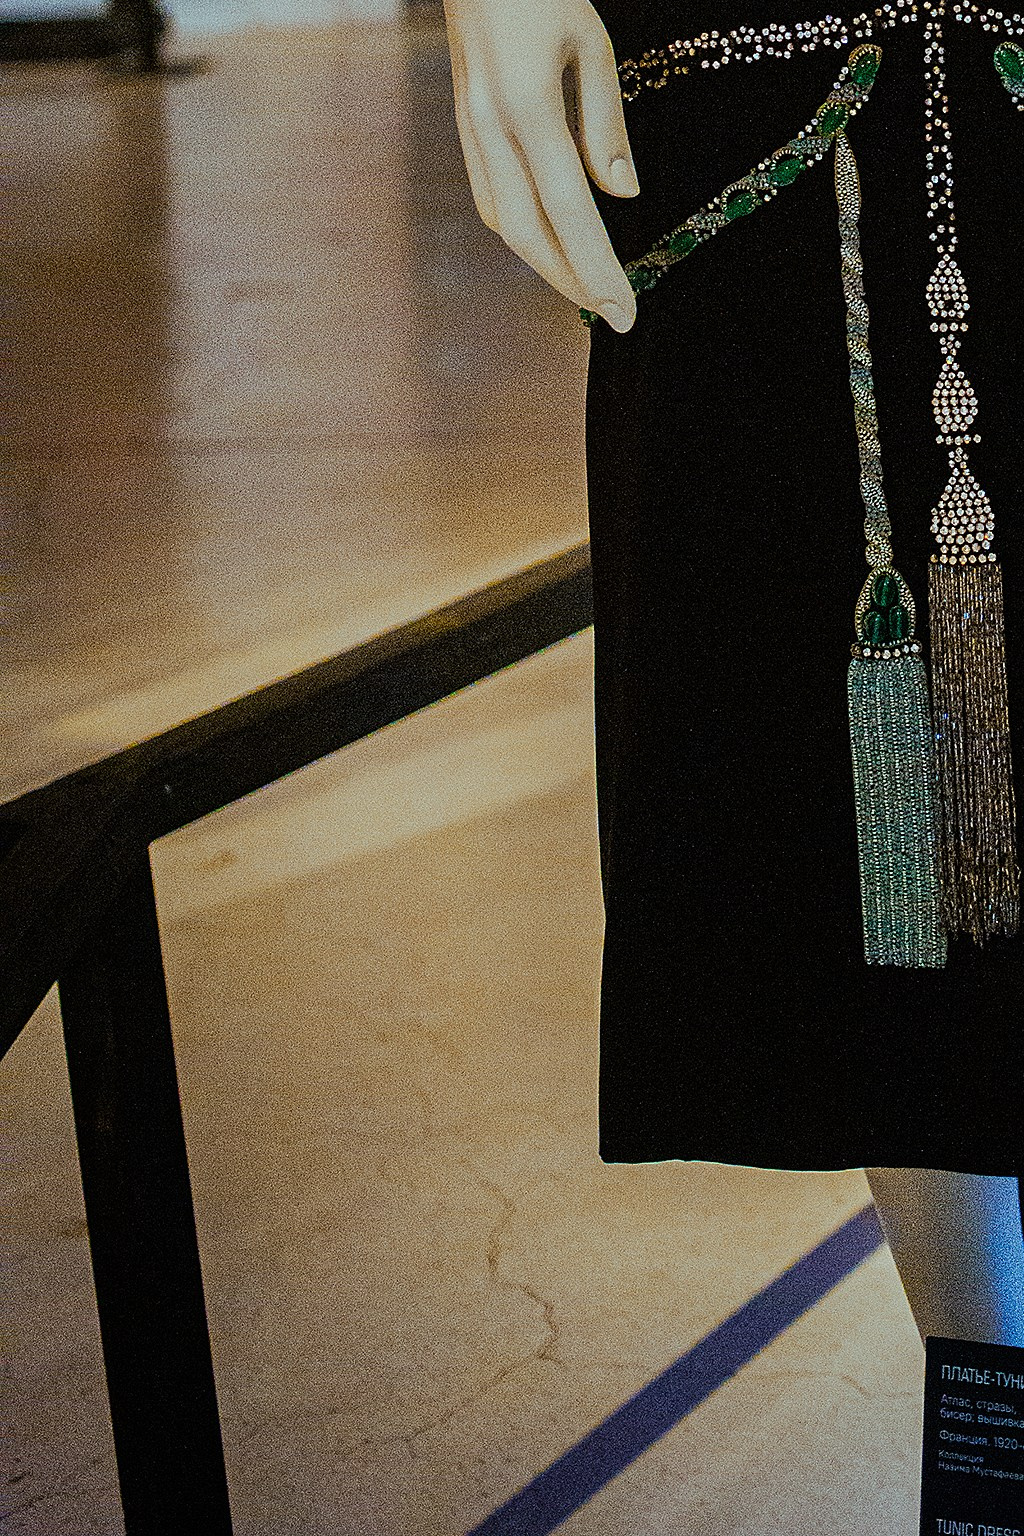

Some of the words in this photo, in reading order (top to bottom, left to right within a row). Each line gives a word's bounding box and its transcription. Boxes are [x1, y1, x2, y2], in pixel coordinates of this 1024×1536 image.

[940, 1393, 973, 1409] Атлас,
[976, 1400, 1017, 1415] стразы,
[938, 1449, 985, 1464] Коллекция
[938, 1461, 970, 1473] Назима
[936, 1518, 974, 1536] TUNIC
